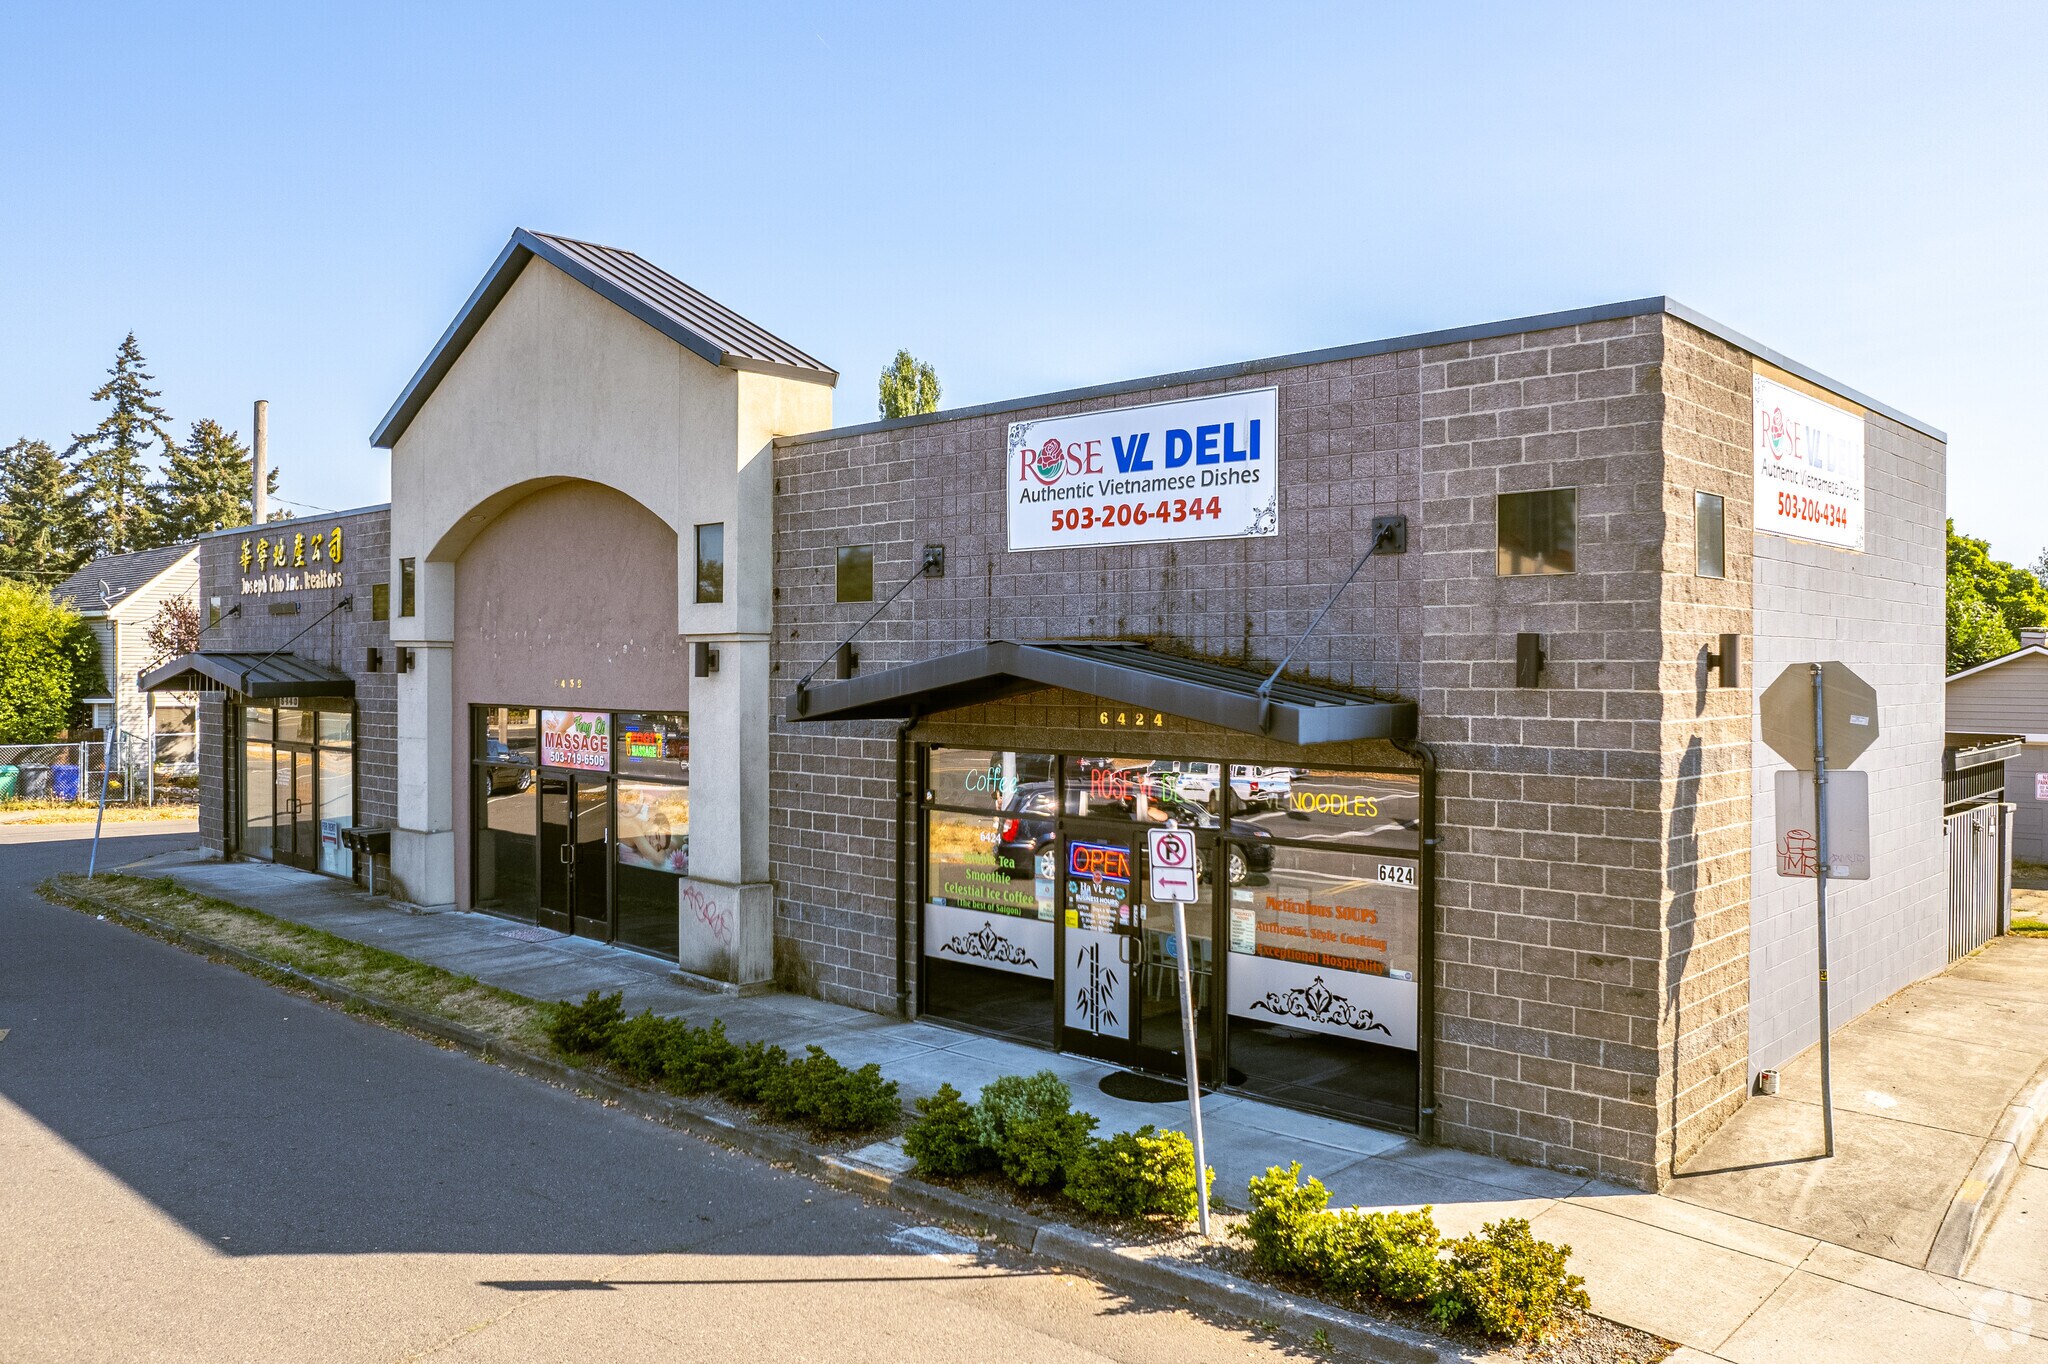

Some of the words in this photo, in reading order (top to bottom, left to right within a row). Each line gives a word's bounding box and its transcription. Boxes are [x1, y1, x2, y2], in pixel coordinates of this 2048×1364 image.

[1019, 439, 1103, 485] ROSE
[1112, 433, 1153, 473] VL
[1165, 419, 1260, 469] DELI
[1020, 483, 1094, 503] Authentic
[1098, 473, 1195, 496] Vietnamese
[1201, 467, 1260, 487] Dishes
[1051, 496, 1221, 531] 503-206-4344
[1778, 491, 1847, 529] 503-206-4344
[241, 575, 267, 597] Joseph
[269, 573, 284, 592] Cho
[286, 573, 303, 591] Inc.
[304, 569, 342, 589] Realtors
[1100, 711, 1163, 727] 6424
[545, 732, 608, 752] MASSAGE
[550, 751, 605, 767] 503-719-6506
[965, 767, 1018, 793] Coffee
[1090, 768, 1133, 801] ROSE
[1290, 791, 1378, 818] NOODLES
[980, 831, 1001, 844] 6424
[998, 855, 1015, 869] Tea
[1073, 847, 1131, 877] OPEN
[1379, 865, 1413, 885] 6424
[966, 868, 1011, 886] Smoothie
[1093, 883, 1104, 894] VL
[945, 881, 984, 898] Celestial
[987, 887, 1000, 901] Ice
[1003, 890, 1034, 905] Coffee
[972, 899, 986, 910] best
[987, 902, 995, 912] of
[996, 904, 1022, 916] Saigon)
[1266, 896, 1333, 918] Meticulous
[1335, 905, 1378, 924] SOUPS
[1256, 920, 1307, 938] Authentic
[1310, 928, 1337, 943] Style
[1340, 933, 1388, 952] Cooking
[1257, 943, 1319, 963] Exceptional
[1321, 953, 1385, 975] Hospitality
